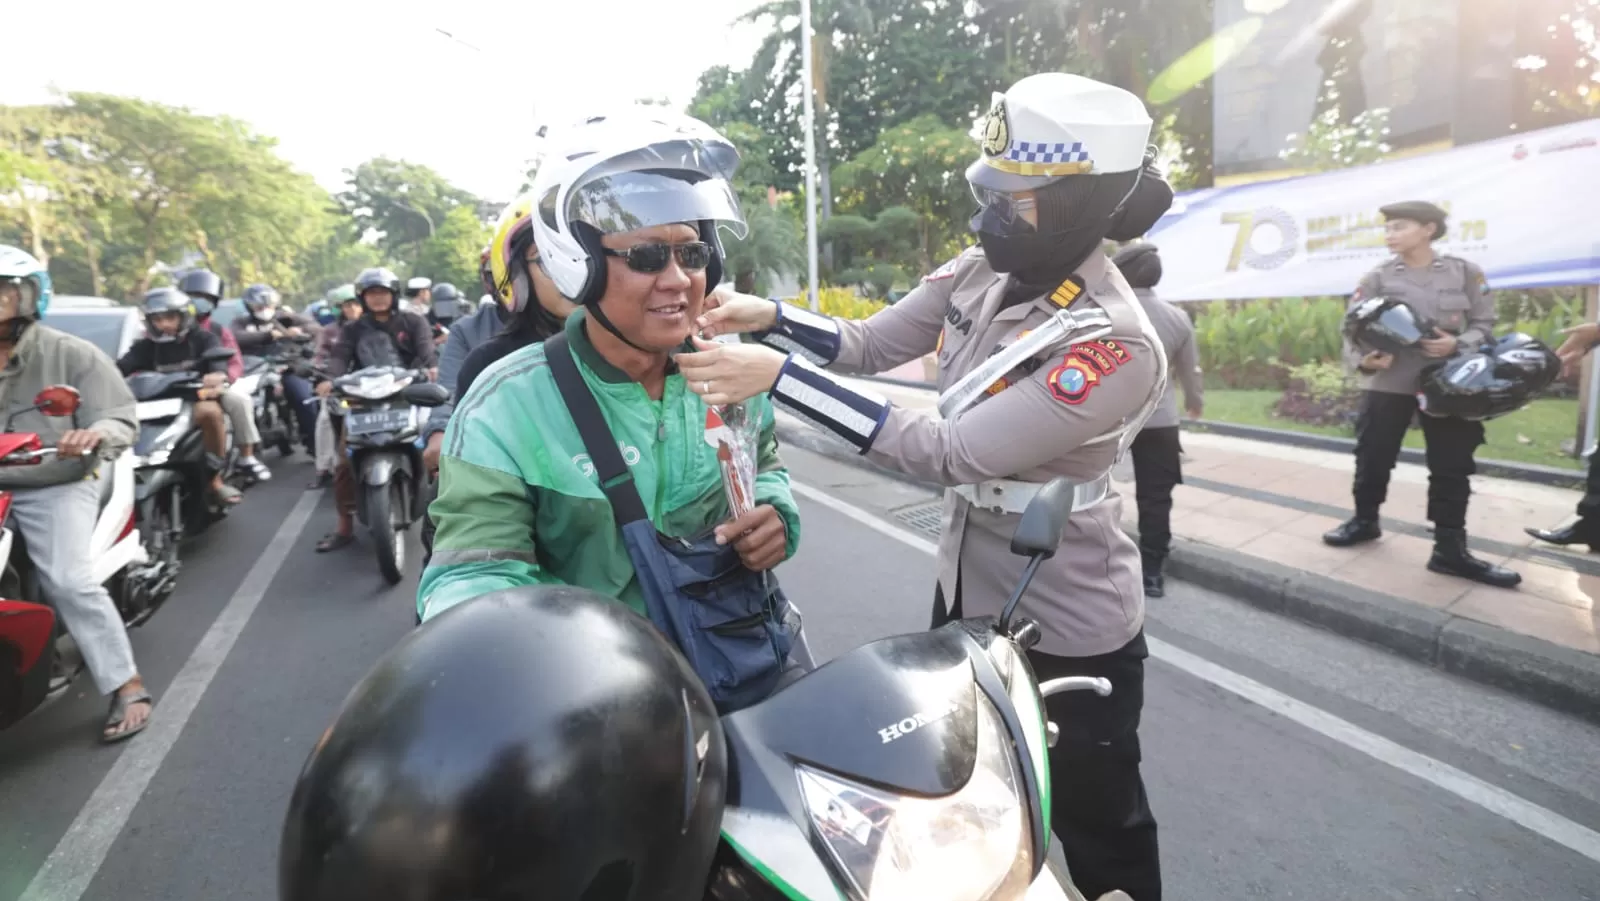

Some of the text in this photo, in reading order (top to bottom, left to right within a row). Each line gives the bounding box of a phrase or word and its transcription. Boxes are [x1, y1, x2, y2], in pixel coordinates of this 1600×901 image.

[1220, 206, 1298, 273] 70
[1076, 346, 1095, 356] JAWA
[572, 440, 641, 478] Gb
[877, 702, 960, 744] HON
